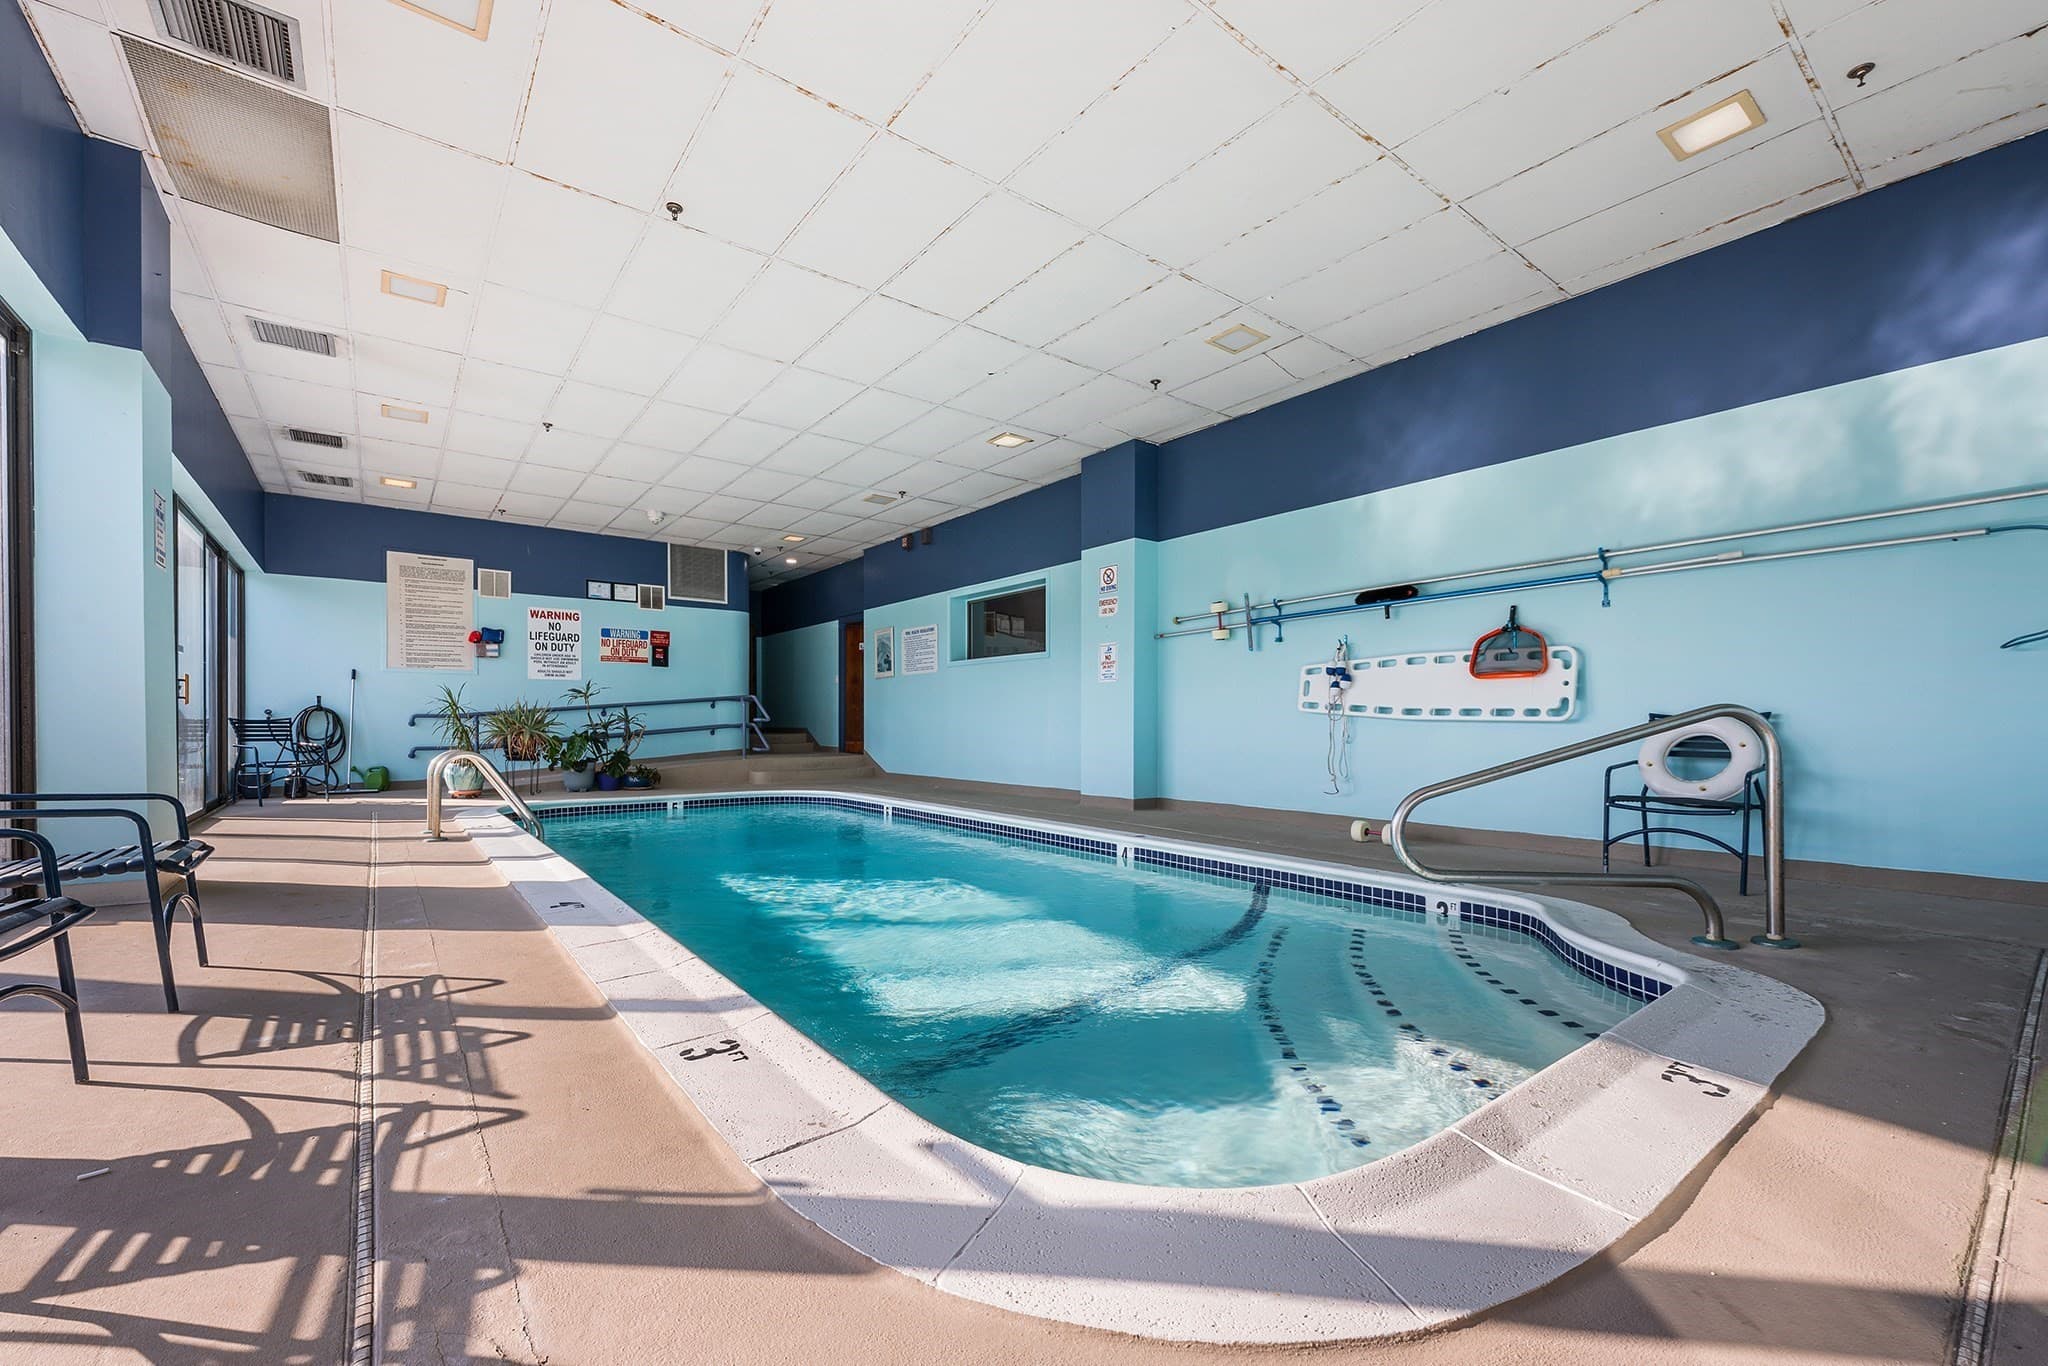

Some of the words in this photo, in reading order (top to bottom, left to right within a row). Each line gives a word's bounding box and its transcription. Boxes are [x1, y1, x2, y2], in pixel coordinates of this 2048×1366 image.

[529, 609, 580, 621] WARNING
[548, 622, 561, 631] NO
[529, 631, 580, 642] LIFEGUARD
[610, 629, 641, 639] WARNING
[534, 642, 548, 651] ON
[550, 642, 575, 652] DUTY
[601, 639, 610, 647] NO
[612, 640, 648, 649] LIFEGUARD
[610, 648, 620, 656] ON
[622, 648, 638, 657] DUTY
[679, 1039, 741, 1061] 3
[727, 1051, 749, 1062] FT
[1661, 1070, 1730, 1097] 3
